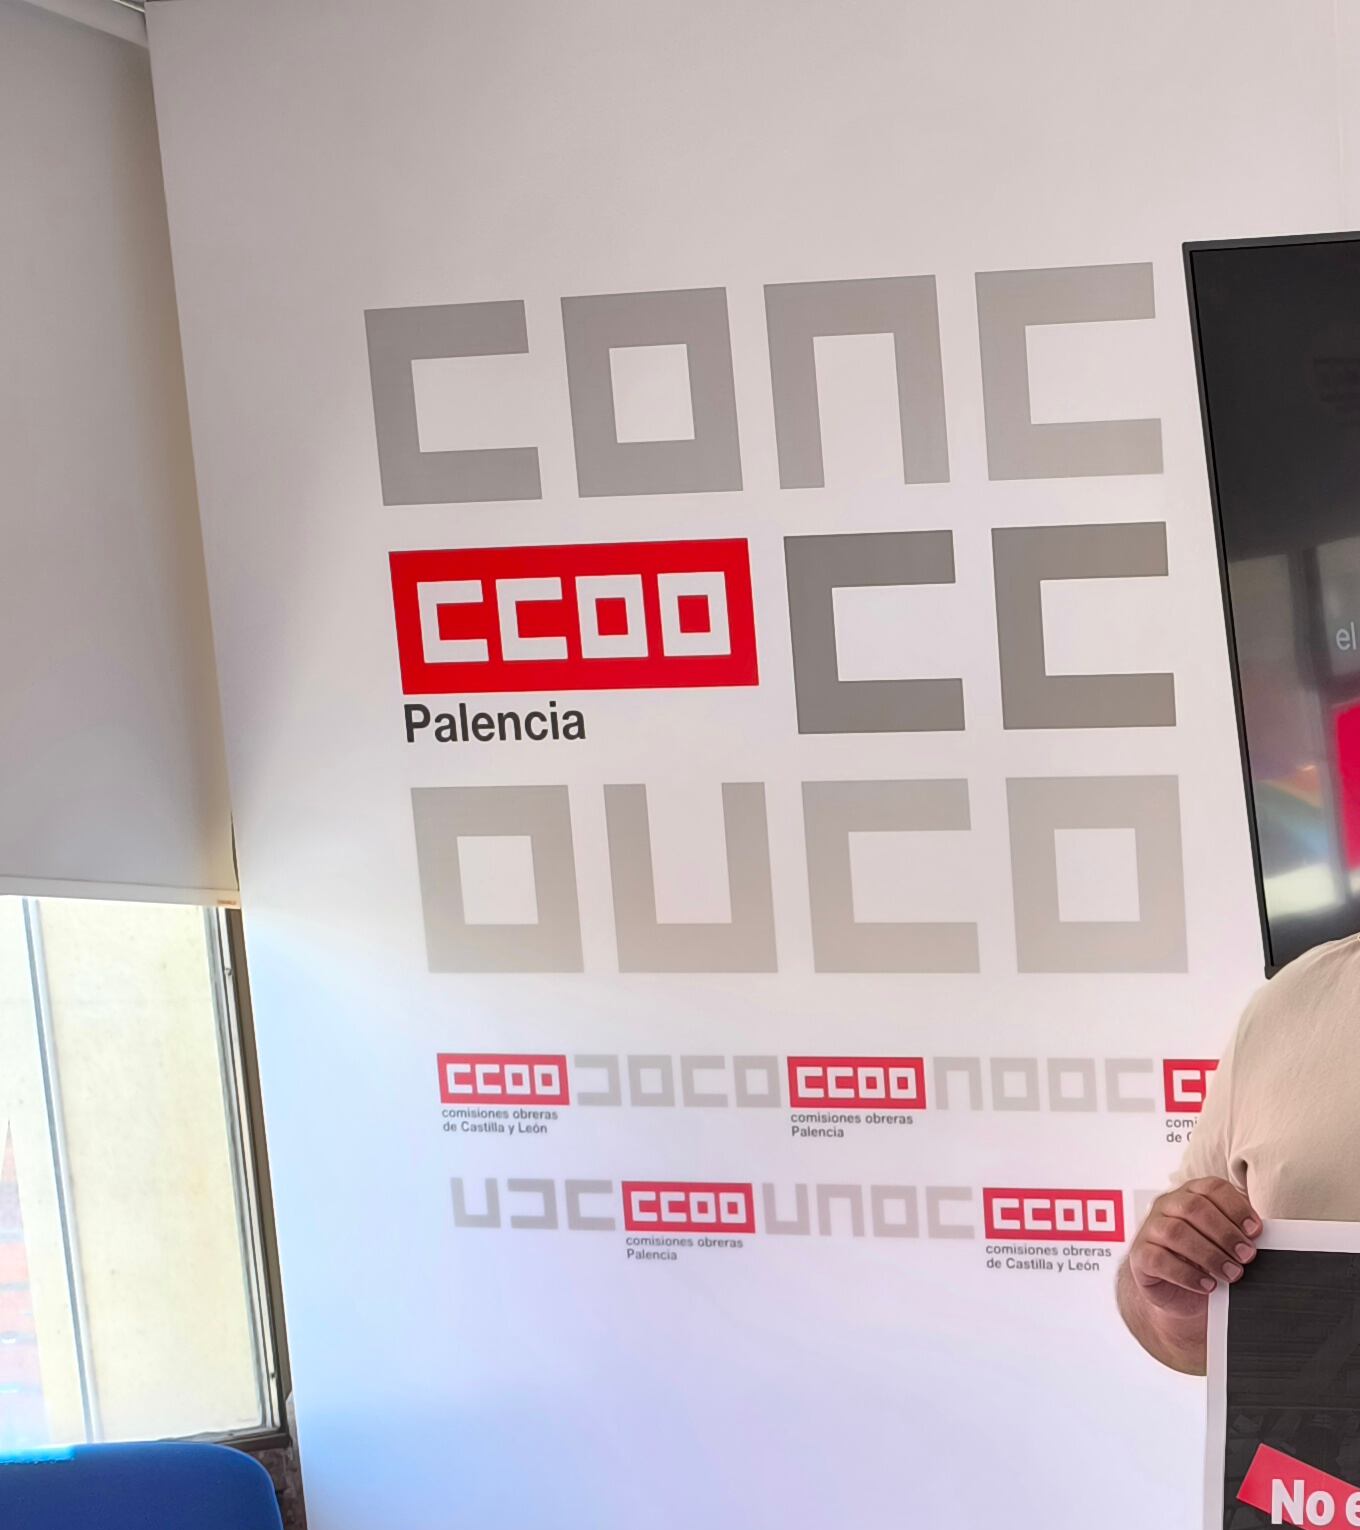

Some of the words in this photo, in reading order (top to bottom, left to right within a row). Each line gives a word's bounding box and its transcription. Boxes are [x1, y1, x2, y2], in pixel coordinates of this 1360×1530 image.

[1336, 622, 1356, 651] el
[404, 702, 586, 745] Palencia
[442, 1108, 509, 1120] comisiones
[513, 1109, 558, 1121] obreras
[791, 1112, 861, 1124] comisiones
[865, 1113, 913, 1125] obreras
[443, 1121, 457, 1133] de
[461, 1121, 505, 1134] Castilla
[508, 1124, 515, 1136] y
[518, 1121, 548, 1134] León
[791, 1126, 845, 1138] Palencia
[1166, 1132, 1182, 1143] de
[626, 1236, 693, 1248] comisiones
[698, 1237, 743, 1248] obreras
[627, 1249, 678, 1261] Palencia
[986, 1244, 1058, 1257] comisiones
[1062, 1245, 1112, 1258] obreras
[986, 1257, 1001, 1269] de
[1006, 1258, 1054, 1271] Castilla
[1057, 1262, 1064, 1273] y
[1068, 1258, 1100, 1271] León
[1270, 1478, 1334, 1526] No
